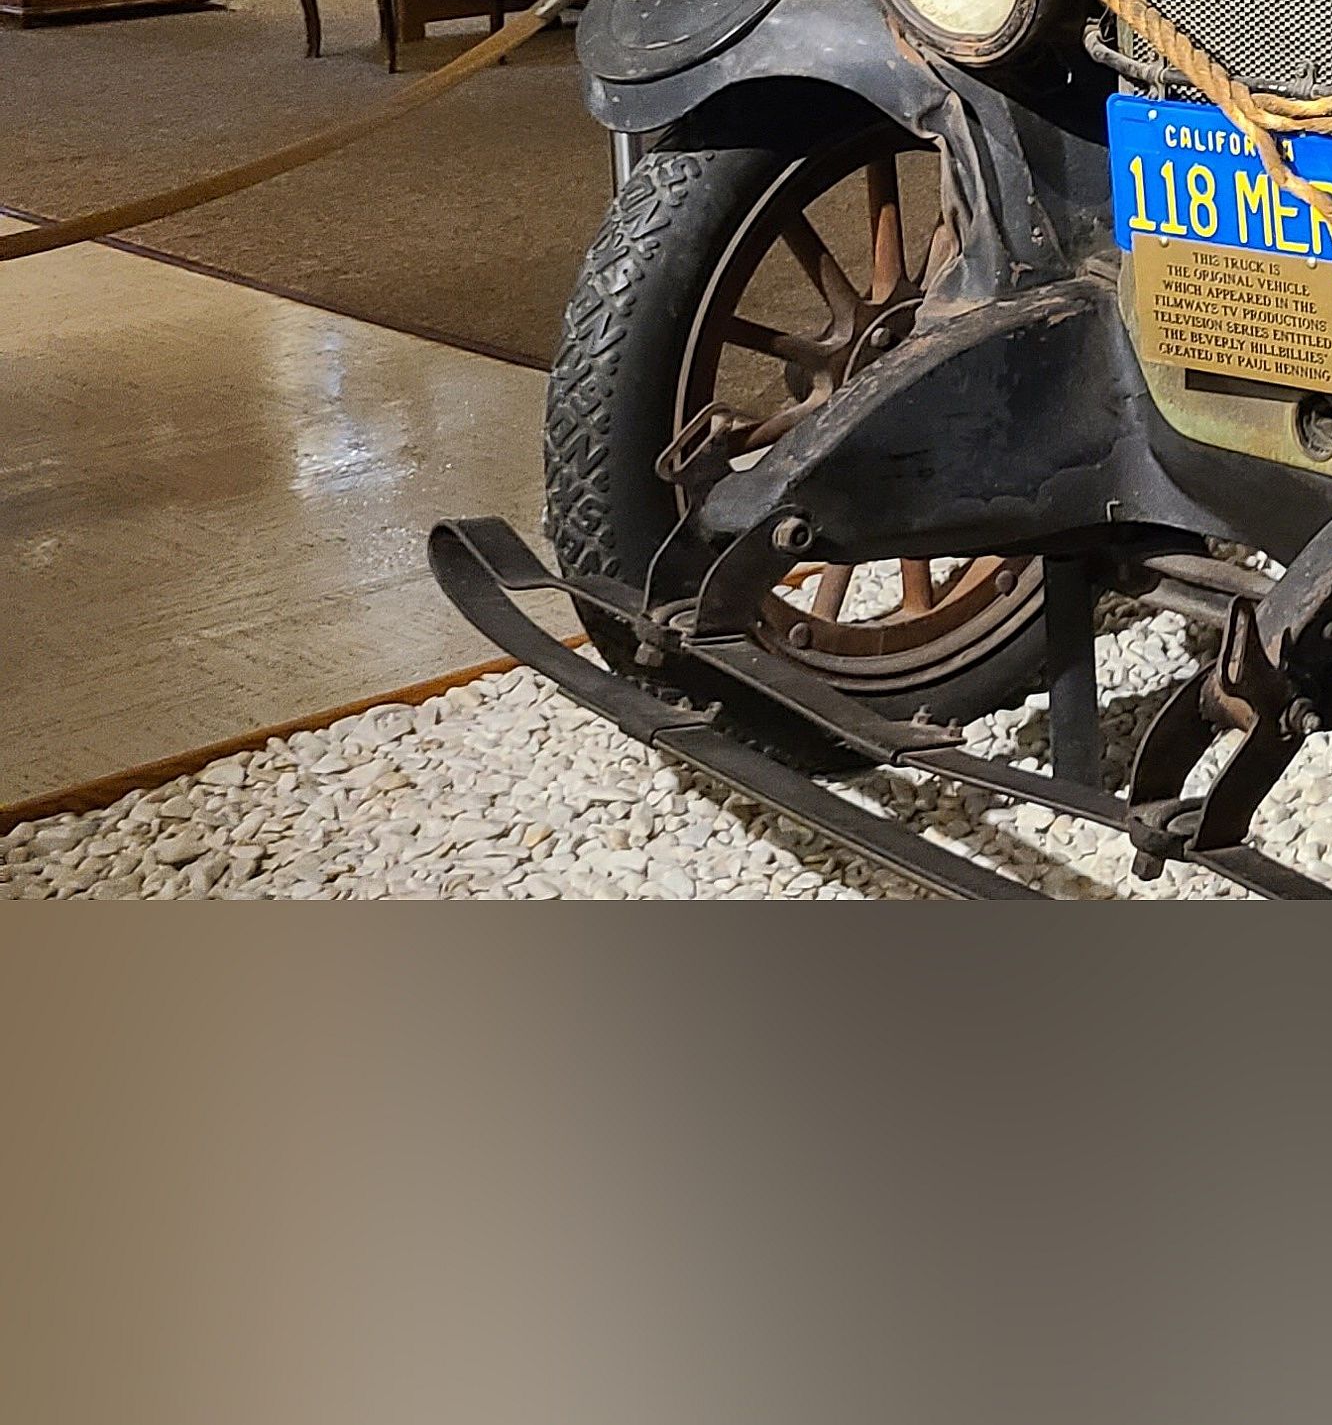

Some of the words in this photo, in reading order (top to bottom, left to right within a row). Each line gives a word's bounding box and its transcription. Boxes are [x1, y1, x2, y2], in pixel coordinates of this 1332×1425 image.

[1164, 124, 1295, 163] CALIFORA
[1129, 155, 1218, 238] 118
[1167, 265, 1191, 279] THE
[1194, 268, 1253, 288] ORIGINAL
[1258, 278, 1310, 297] VEHICLE
[1192, 252, 1220, 267] THIS
[1224, 257, 1265, 273] TRUCK
[1269, 263, 1280, 276] IS
[1154, 294, 1219, 315] FILMWAYS
[1221, 305, 1238, 317] TV
[1243, 308, 1327, 332] PRODUCTIONS
[1163, 280, 1202, 296] WHICH
[1207, 287, 1271, 307] APPEARED
[1275, 297, 1288, 309] IN
[1293, 300, 1317, 314] THE
[1153, 310, 1222, 331] TELEVISION
[1226, 321, 1269, 339] SERIES
[1273, 330, 1332, 350] ENTITLED
[1190, 332, 1246, 351] BEVERLY
[1159, 342, 1212, 362] CREATED
[1217, 352, 1233, 365] BY
[1238, 356, 1271, 372] PAUL
[1275, 361, 1331, 382] HENNING
